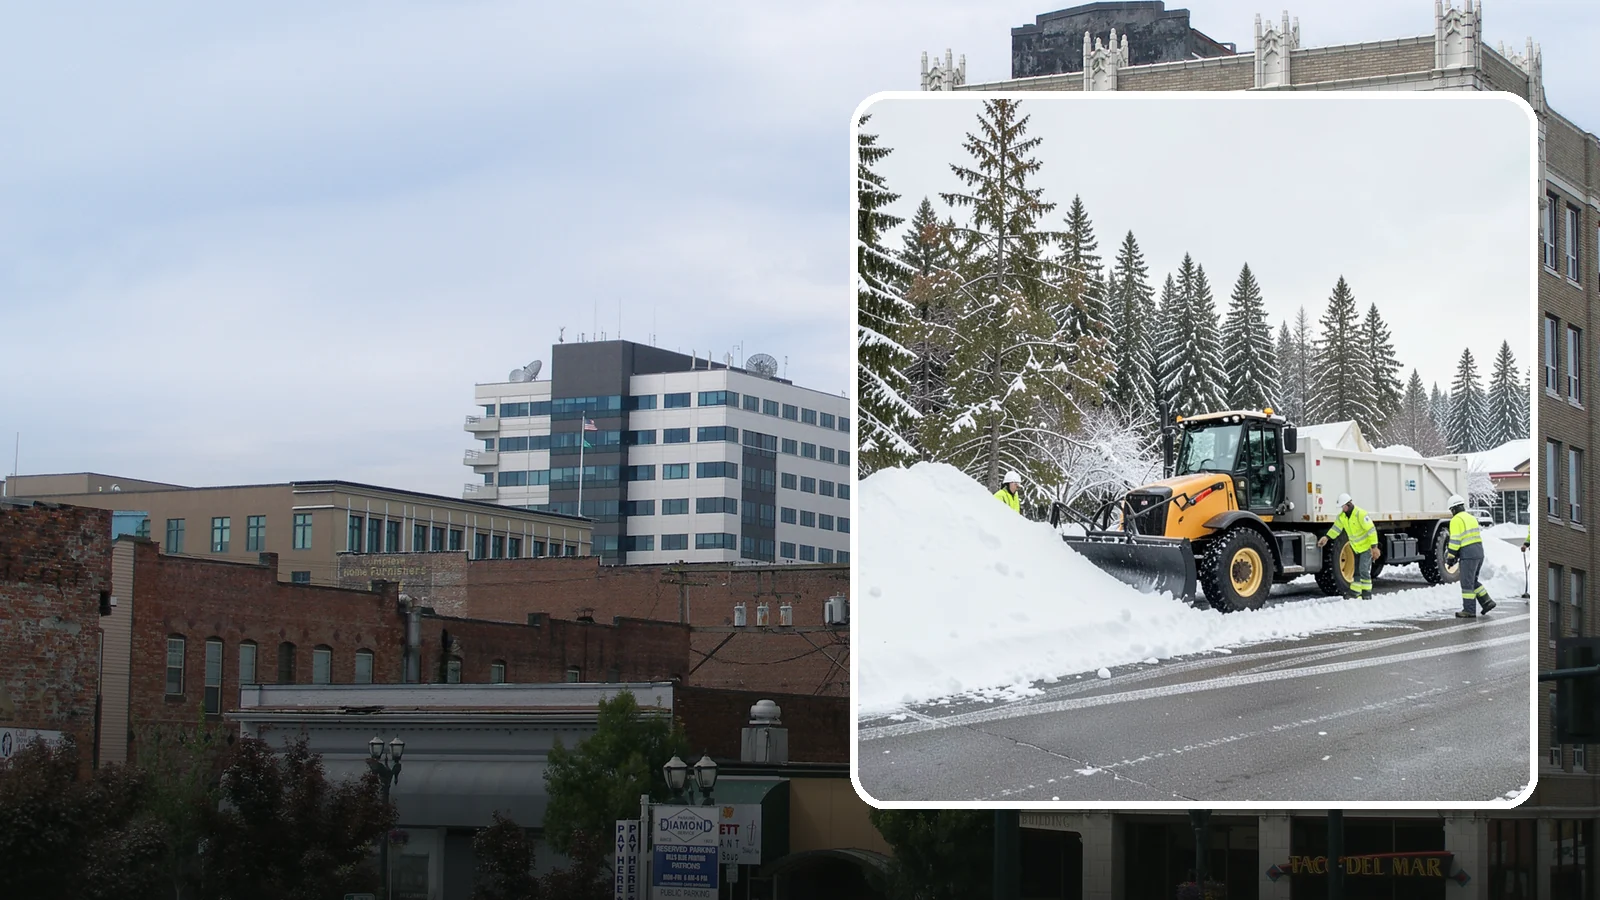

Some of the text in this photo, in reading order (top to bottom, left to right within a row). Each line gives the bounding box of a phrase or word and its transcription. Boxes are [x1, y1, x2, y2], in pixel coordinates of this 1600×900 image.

[370, 566, 427, 577] Furnishers
[660, 818, 713, 833] DIAMOND
[1021, 814, 1070, 828] BUILDING
[719, 824, 740, 835] ETT
[719, 839, 740, 848] ANT
[656, 845, 716, 854] RESERVED PARKING
[617, 825, 625, 893] PAY HERE
[627, 824, 637, 893] PAY HERE
[722, 851, 739, 862] Soup
[671, 862, 701, 870] PATRONS
[1346, 856, 1385, 876] DEL
[1392, 857, 1442, 877] MAR
[660, 888, 710, 898] PUBLIC PARKING
